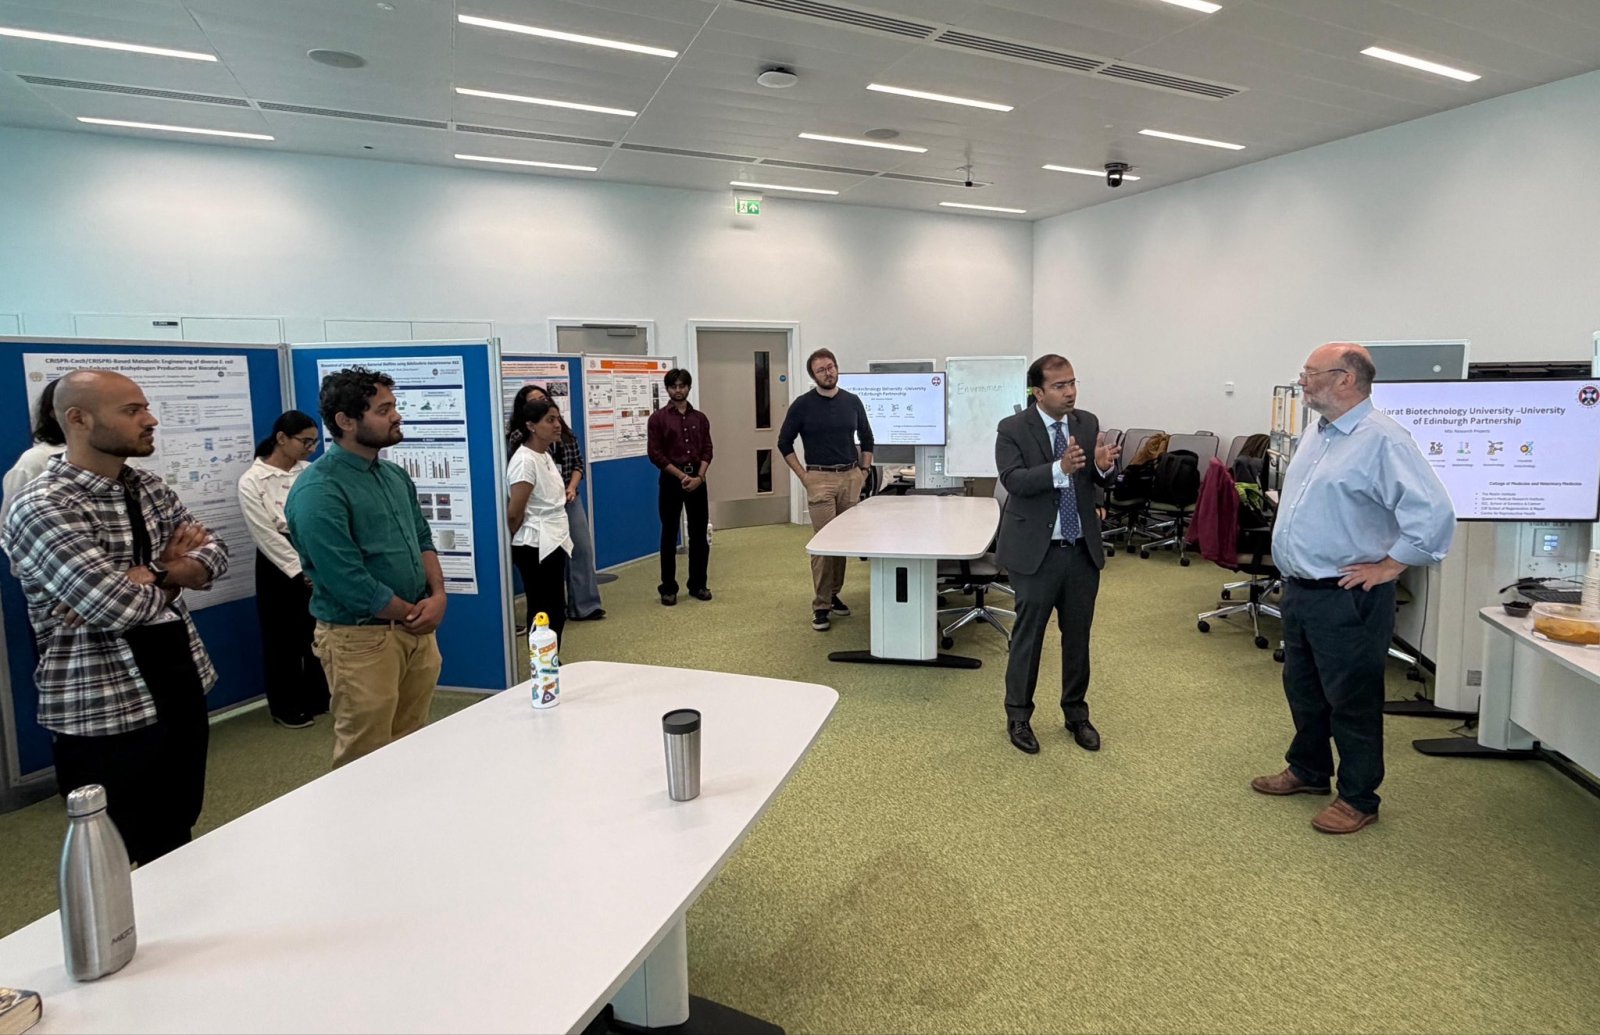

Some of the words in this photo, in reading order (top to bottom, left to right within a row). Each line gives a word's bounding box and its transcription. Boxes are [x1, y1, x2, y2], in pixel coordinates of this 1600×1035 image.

[1405, 407, 1467, 417] Biotechnology
[1469, 406, 1514, 416] University
[1413, 417, 1422, 425] of
[1423, 417, 1468, 427] Edinburgh
[1470, 416, 1522, 426] Partnership
